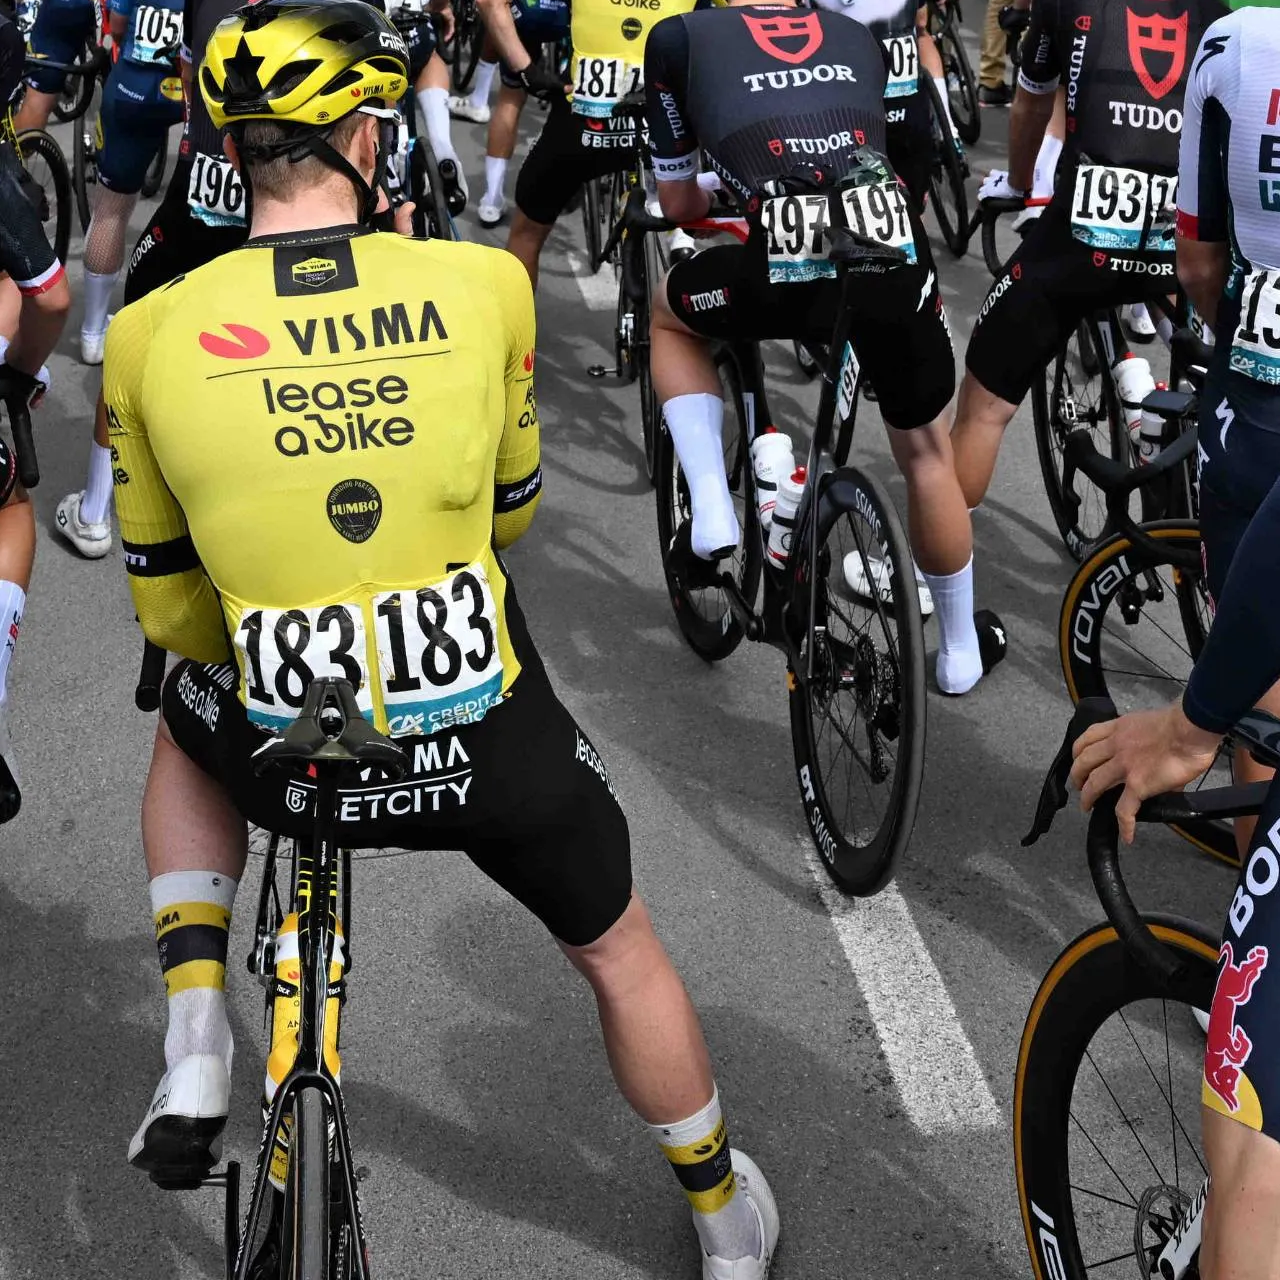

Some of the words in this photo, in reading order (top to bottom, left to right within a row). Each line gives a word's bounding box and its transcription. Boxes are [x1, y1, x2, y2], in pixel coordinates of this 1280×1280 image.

[379, 31, 408, 55] GIR
[363, 84, 385, 96] VISMA
[574, 58, 618, 98] 181
[742, 64, 857, 93] TUDOR
[1067, 34, 1087, 112] TUDOR
[660, 92, 686, 139] TUDOR
[1109, 100, 1183, 134] TUDO
[785, 131, 854, 156] TUDOR
[190, 156, 244, 212] 196
[659, 159, 692, 172] BOSS
[1076, 168, 1143, 224] 193
[764, 196, 830, 255] 197
[845, 183, 909, 242] 197
[128, 234, 156, 274] TUDOR
[1110, 257, 1175, 276] TUDOR
[690, 290, 726, 312] TUDOR
[977, 273, 1013, 326] TUDOR
[283, 299, 449, 357] VISMA
[262, 373, 410, 415] lease
[331, 499, 379, 516] JUMBO
[240, 604, 365, 709] 183
[376, 570, 494, 694] 183
[428, 692, 493, 723] CRÉDIT
[340, 775, 473, 821] ETCITY
